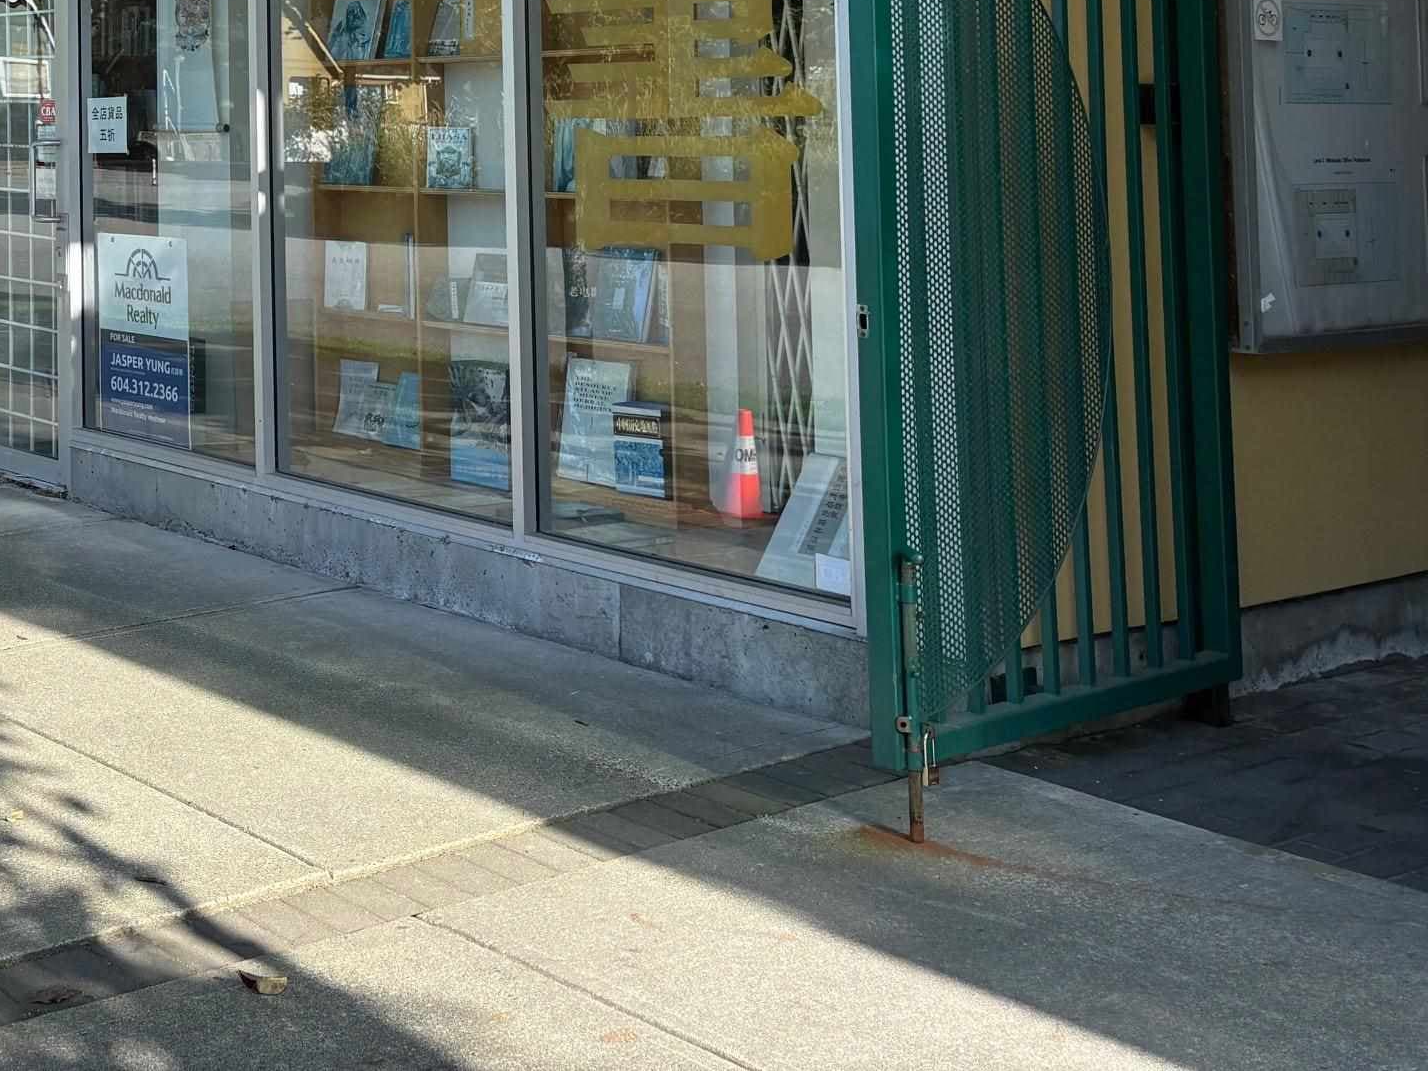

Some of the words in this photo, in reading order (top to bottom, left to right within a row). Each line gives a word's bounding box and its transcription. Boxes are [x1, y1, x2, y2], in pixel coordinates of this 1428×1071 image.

[91, 105, 124, 121] 全店貨品
[99, 128, 116, 142] 五折
[114, 280, 172, 305] Macdonald
[126, 304, 160, 330] Realty
[109, 332, 121, 341] FOR
[122, 334, 135, 344] SALE
[110, 353, 144, 370] JASPER
[145, 358, 171, 374] YUNG
[110, 376, 179, 402] 604.312.2366
